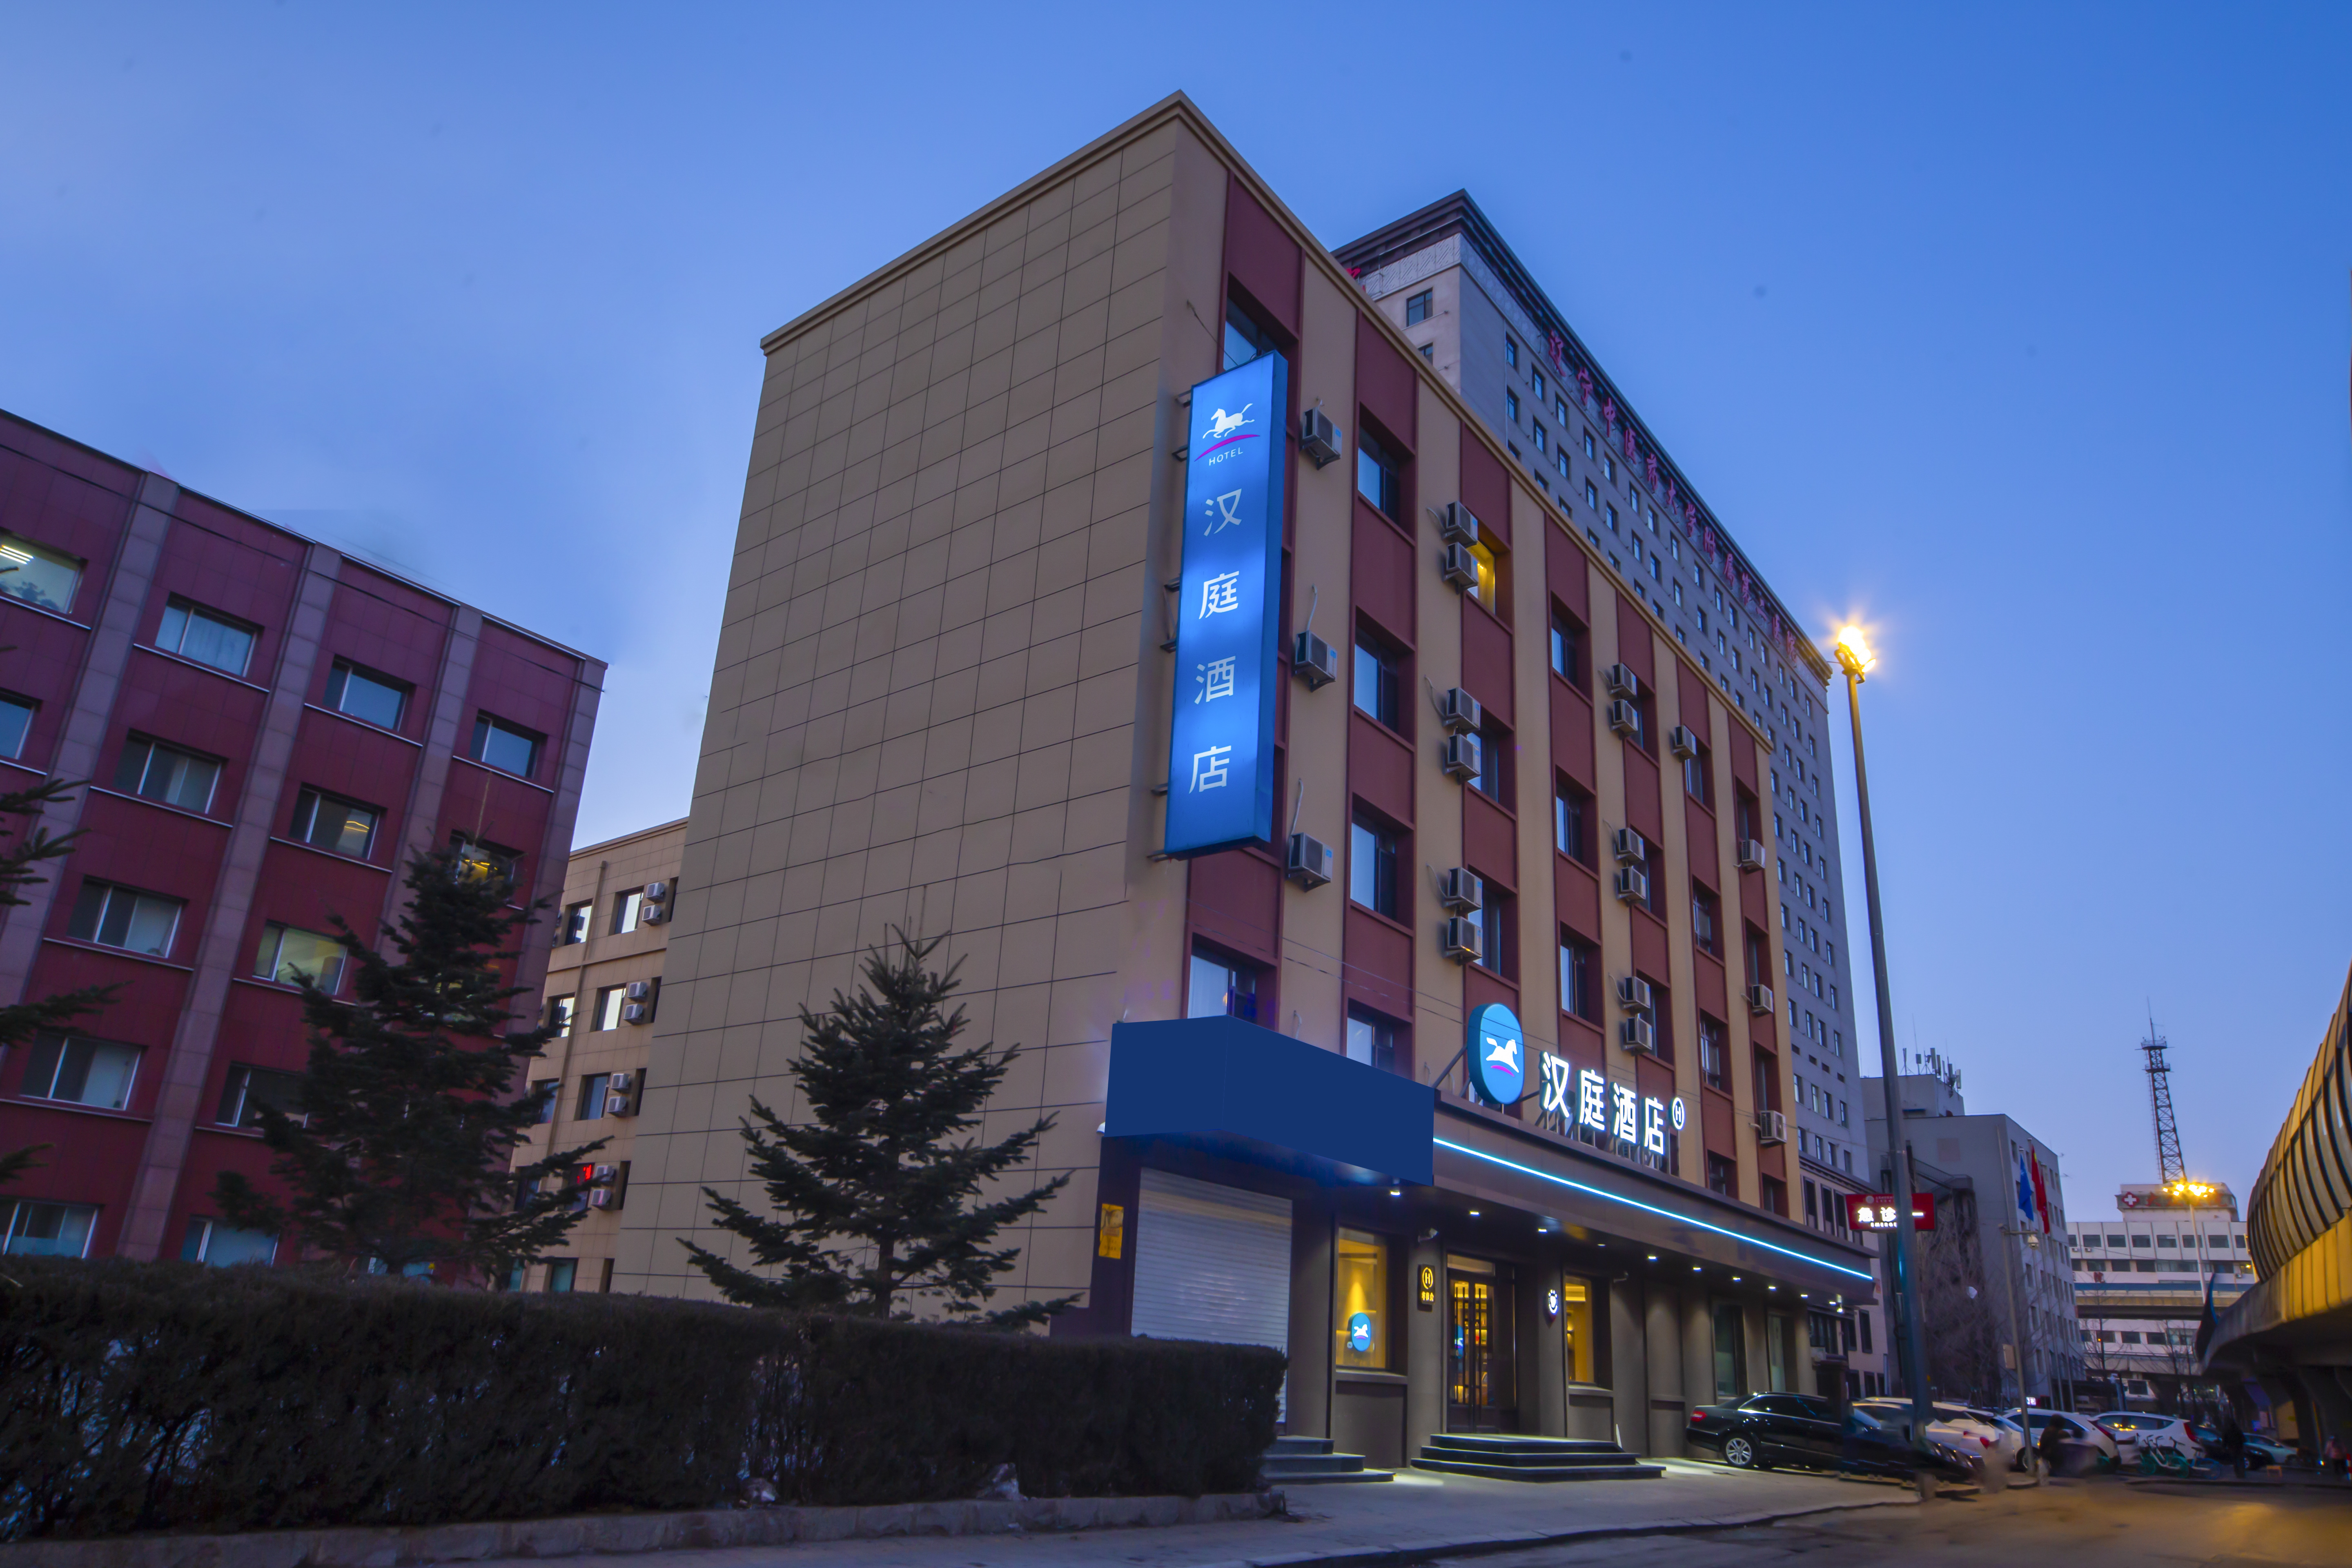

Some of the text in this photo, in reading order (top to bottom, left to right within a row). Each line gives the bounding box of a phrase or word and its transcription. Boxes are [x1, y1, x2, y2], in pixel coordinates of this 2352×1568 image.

[1209, 447, 1243, 466] HOTEL
[1189, 488, 1242, 793] 汉庭酒店
[1542, 1051, 1665, 1155] 汉庭酒店
[1857, 1207, 1897, 1222] 急诊
